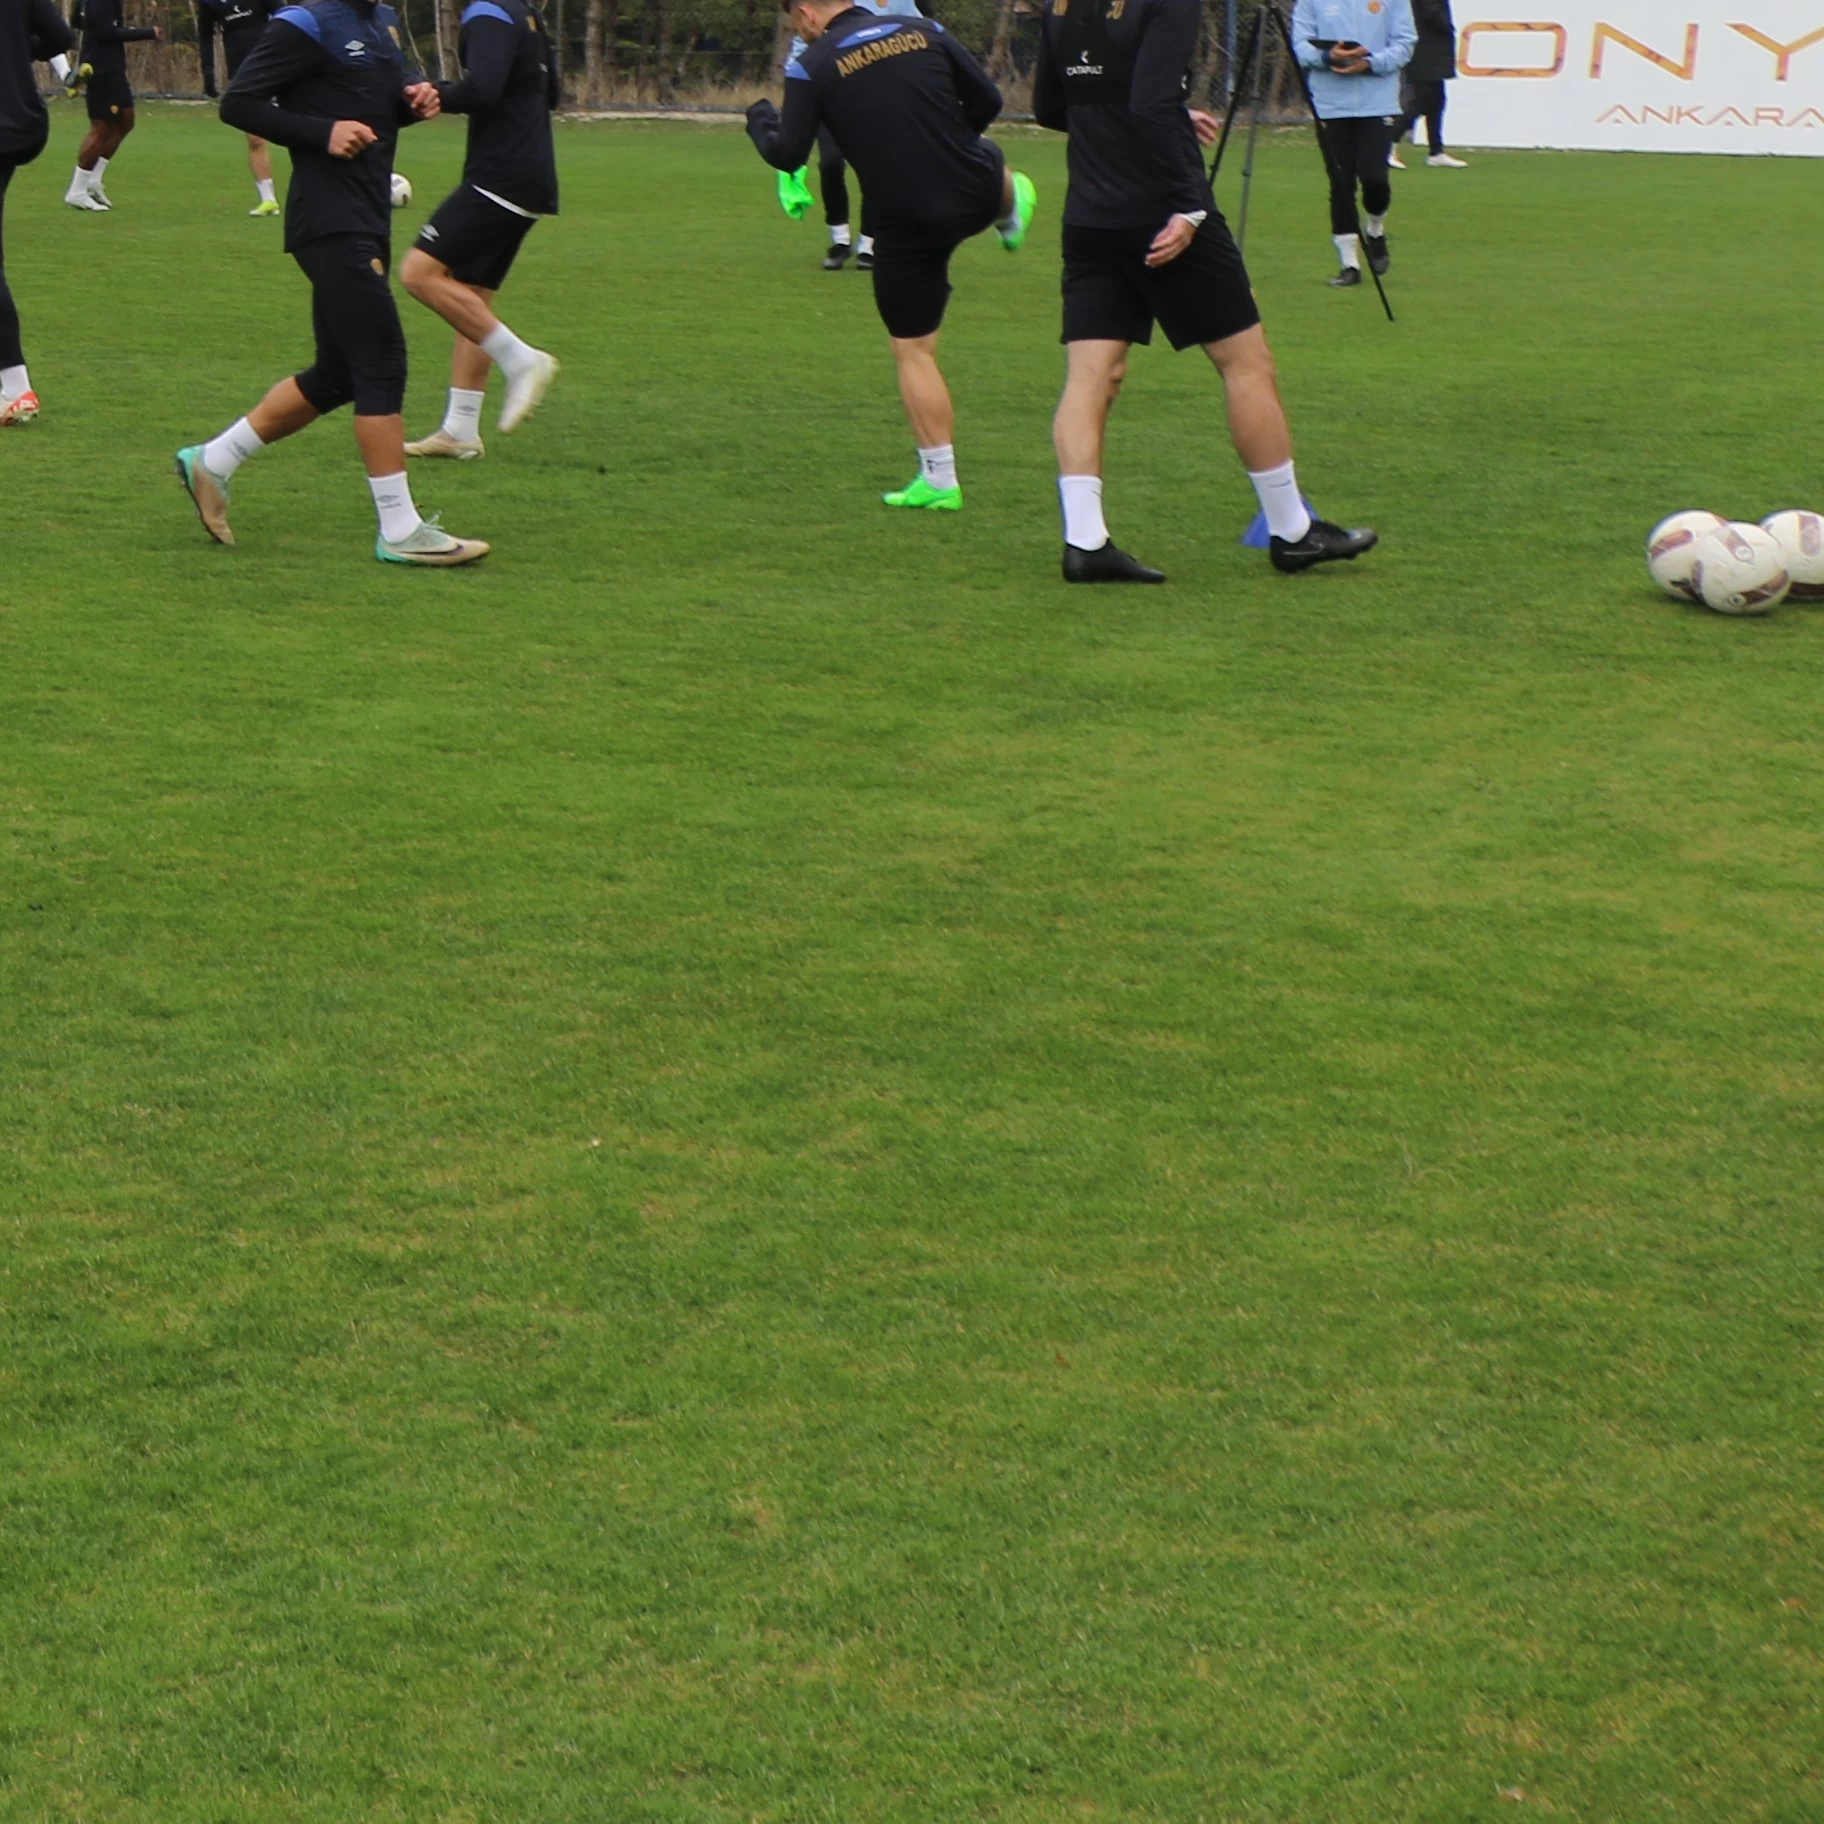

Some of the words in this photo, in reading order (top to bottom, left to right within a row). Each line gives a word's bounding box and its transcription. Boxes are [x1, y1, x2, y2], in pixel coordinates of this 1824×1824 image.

[835, 29, 928, 78] ANKARAGÜCÜ
[1066, 65, 1104, 76] CATAPULT
[1595, 104, 1824, 127] ANKARA
